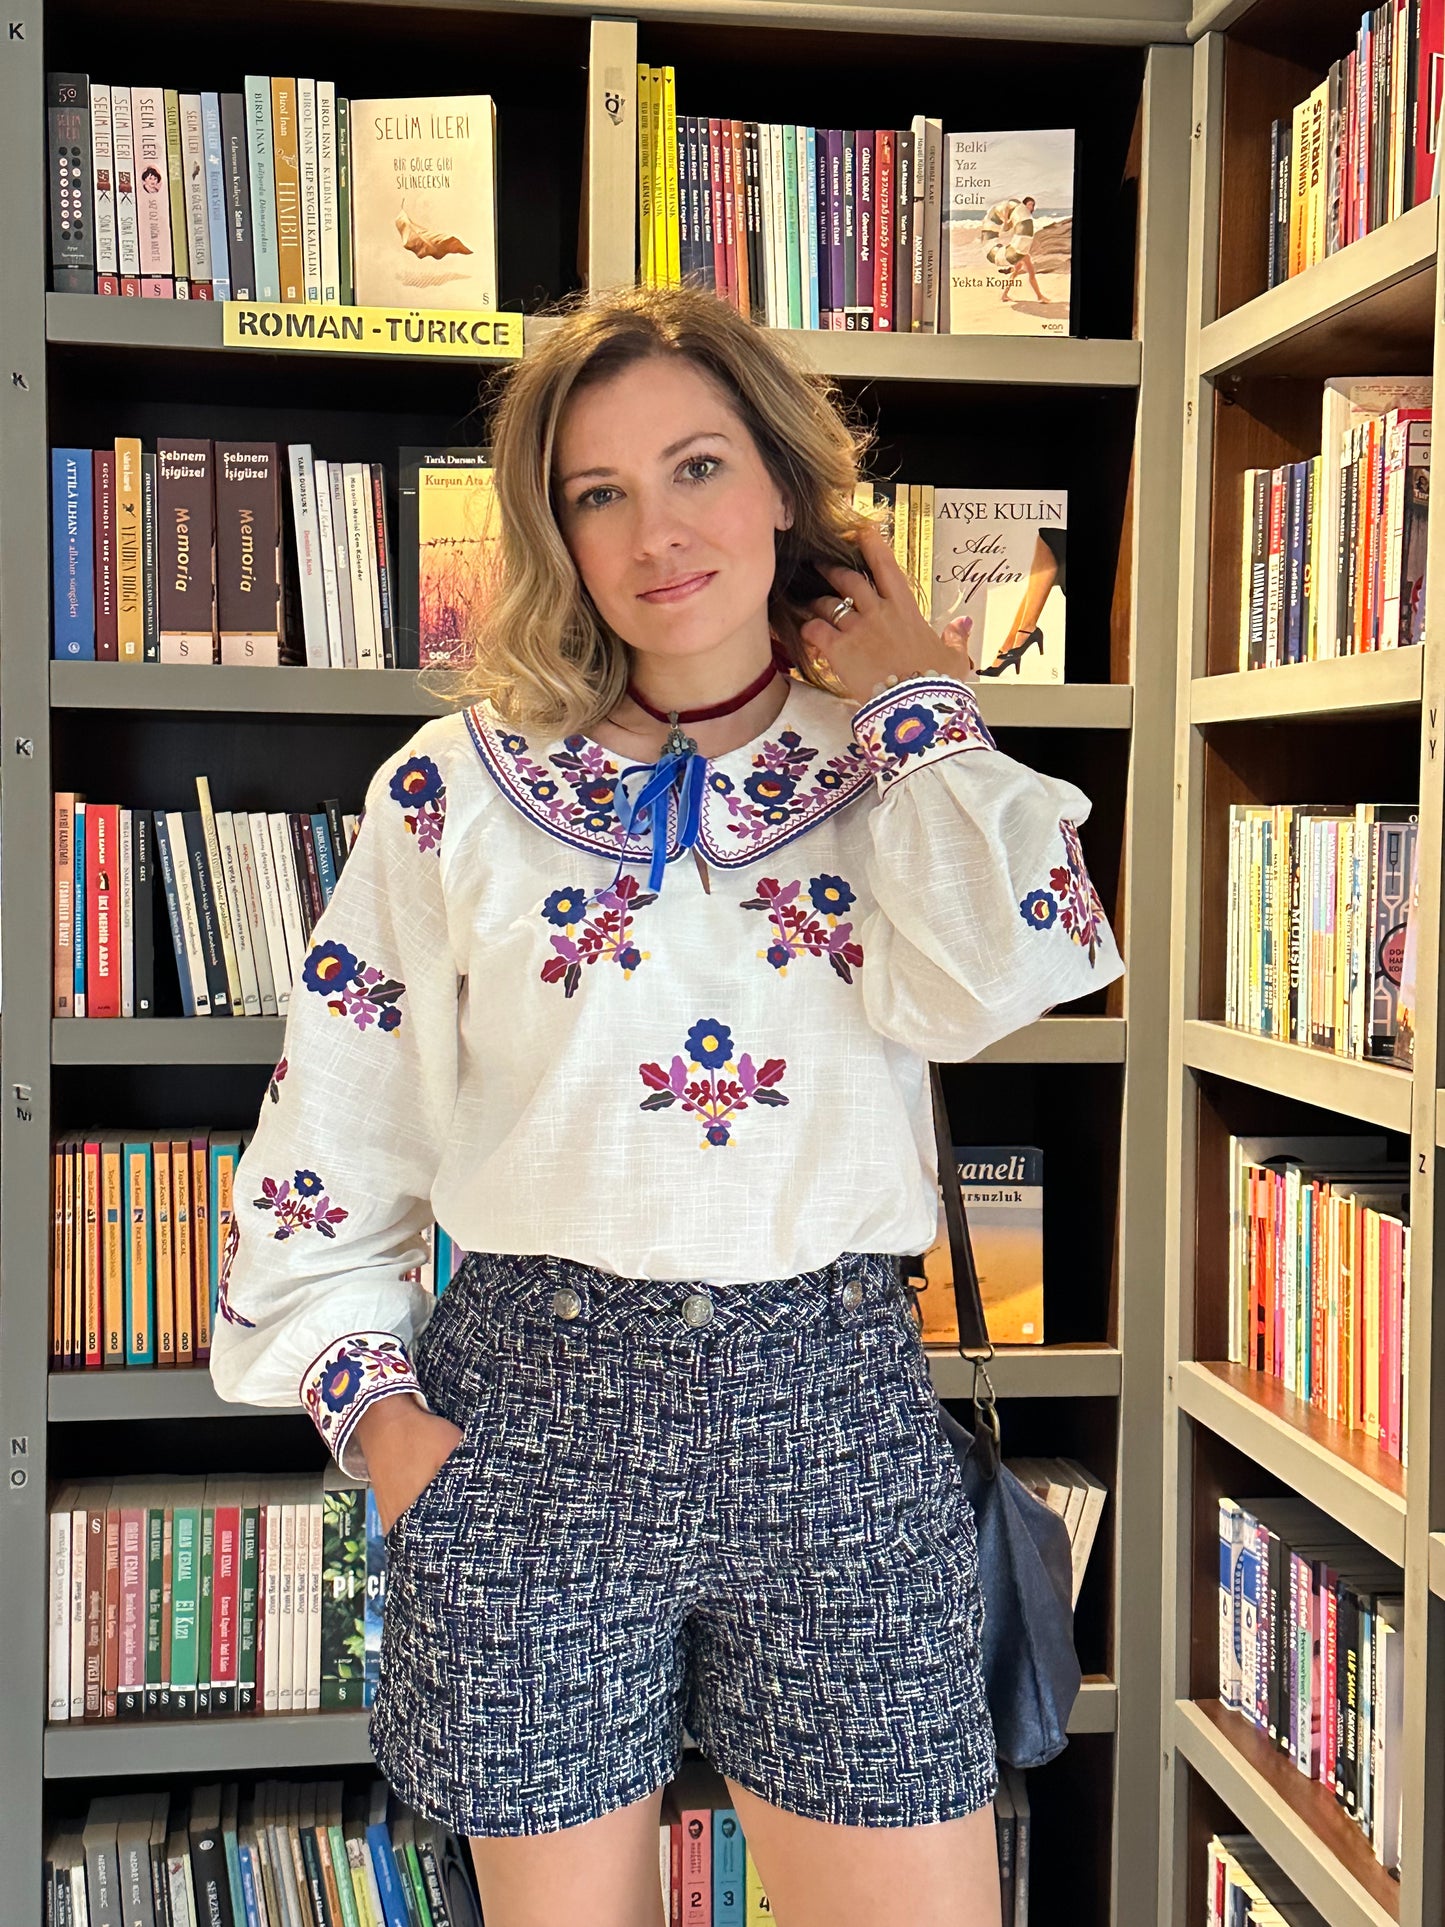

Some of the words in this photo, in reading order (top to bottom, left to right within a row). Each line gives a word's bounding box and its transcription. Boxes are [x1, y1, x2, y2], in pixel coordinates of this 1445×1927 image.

[9, 23, 25, 40] K
[279, 91, 289, 114] Birol
[140, 98, 156, 129] SELİM
[187, 110, 198, 134] SELİM
[321, 98, 331, 129] BİROL
[375, 113, 421, 140] SELİM
[431, 113, 470, 139] İLERİ
[142, 134, 158, 160] İLERİ
[188, 135, 199, 154] İLERİ
[322, 132, 332, 159] İNAN
[956, 141, 987, 153] Belki
[305, 162, 314, 182] HEP
[410, 157, 434, 171] GÖLGE
[437, 156, 453, 170] GİBİ
[955, 159, 977, 171] Yaz
[397, 174, 451, 189] SİLİNECEKSİN
[955, 177, 991, 188] Erken
[954, 193, 985, 205] Gelir
[324, 207, 333, 232] PERA
[952, 277, 983, 288] Yekta
[986, 276, 1022, 289] Kopan
[239, 311, 363, 340] ROMAN
[159, 450, 206, 466] Şebnem
[223, 452, 269, 468] Şebnem
[477, 455, 487, 464] K.
[425, 474, 463, 489] Kurşun
[466, 474, 485, 487] Ata
[67, 501, 78, 535] İLHAN
[937, 502, 988, 524] AYŞE
[994, 500, 1063, 519] KULİN
[121, 525, 138, 572] YENİDEN
[174, 507, 193, 592] Memoria
[238, 509, 257, 593] Memoria
[936, 559, 1024, 603] Aylin
[120, 575, 138, 613] DOĞUŞ
[1430, 708, 1437, 728] V
[1429, 739, 1437, 759] Y
[98, 895, 109, 911] İKİ
[98, 912, 109, 943] NEHİR
[99, 945, 109, 977] ARASI
[1419, 1153, 1426, 1174] Z
[12, 1438, 27, 1455] N
[124, 1555, 138, 1588] KEMAL
[178, 1551, 193, 1582] KEMAL
[175, 1600, 194, 1611] El
[691, 1892, 702, 1907] 2
[723, 1890, 735, 1907] 3
